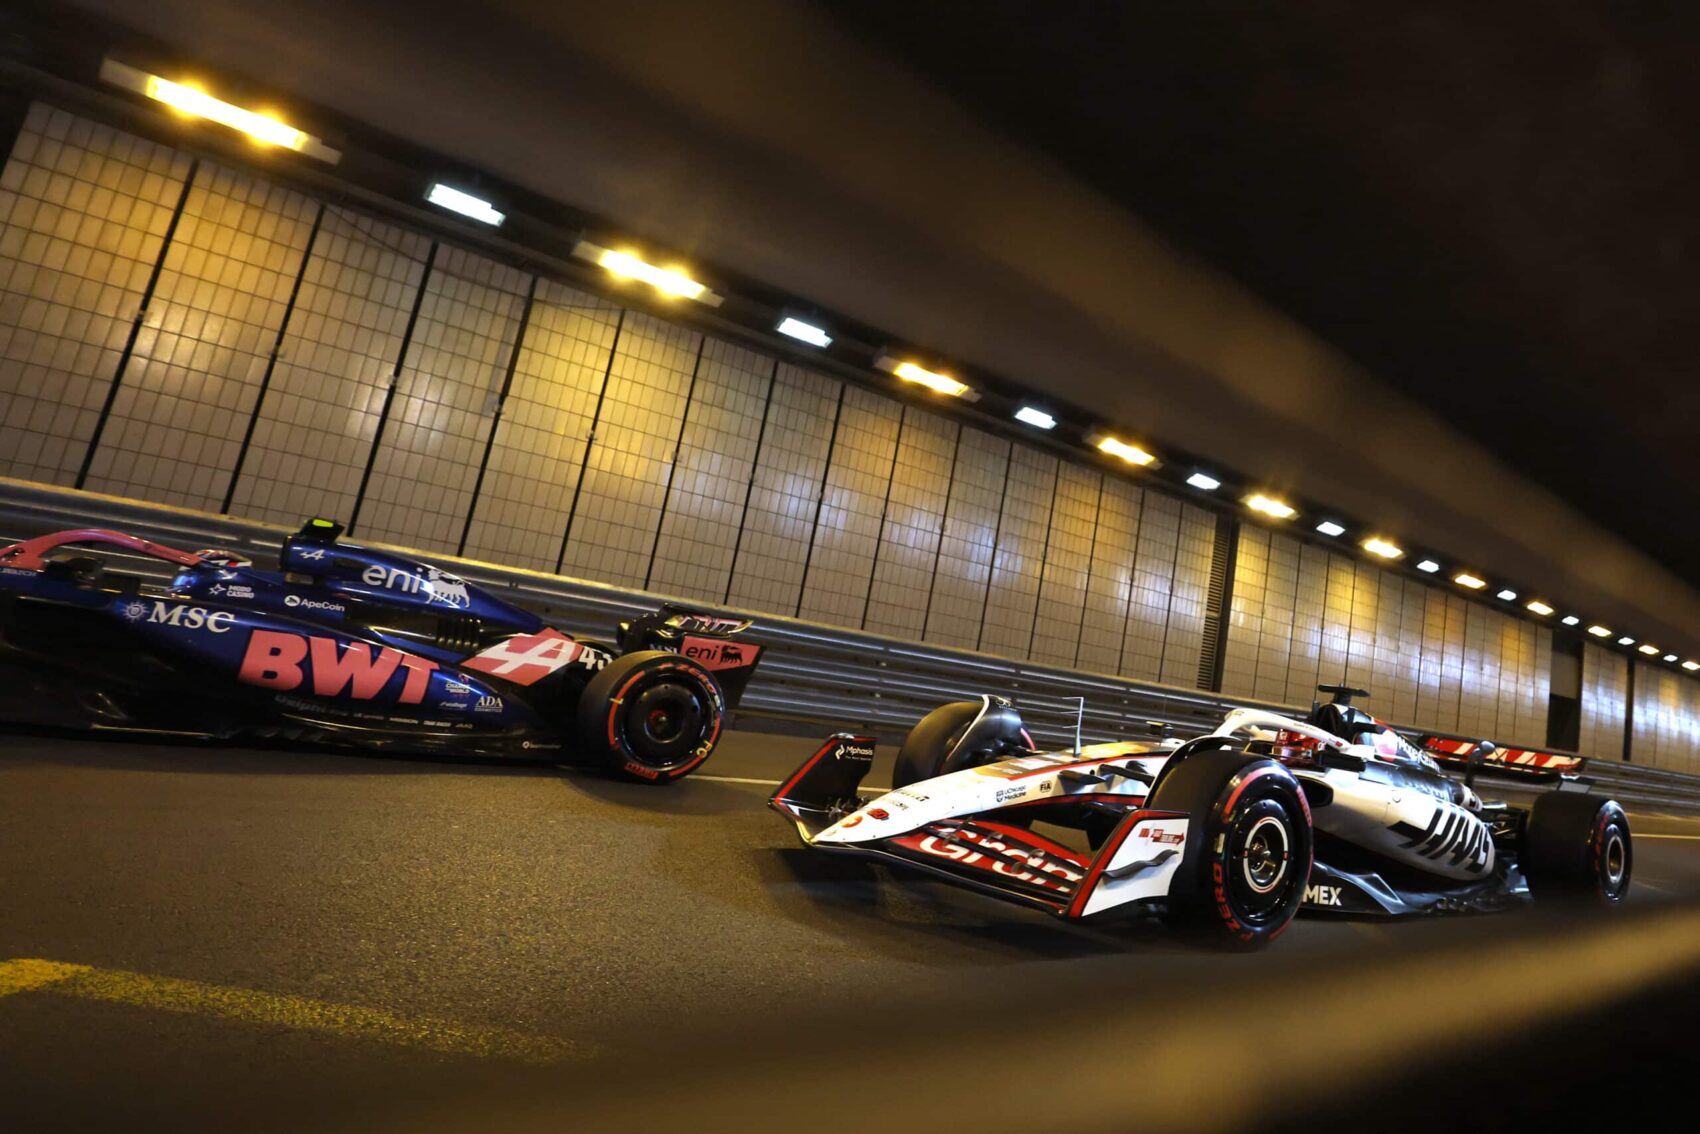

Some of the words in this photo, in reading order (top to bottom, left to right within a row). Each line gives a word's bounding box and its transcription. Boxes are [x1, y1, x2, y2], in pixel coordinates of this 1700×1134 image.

[362, 564, 424, 594] eni
[300, 598, 345, 612] ApeCoin
[146, 600, 236, 633] MSC
[685, 645, 719, 661] eni
[238, 629, 440, 705] BWT
[475, 695, 503, 709] ADA
[845, 745, 873, 756] Mphasis
[1040, 782, 1051, 791] FIA
